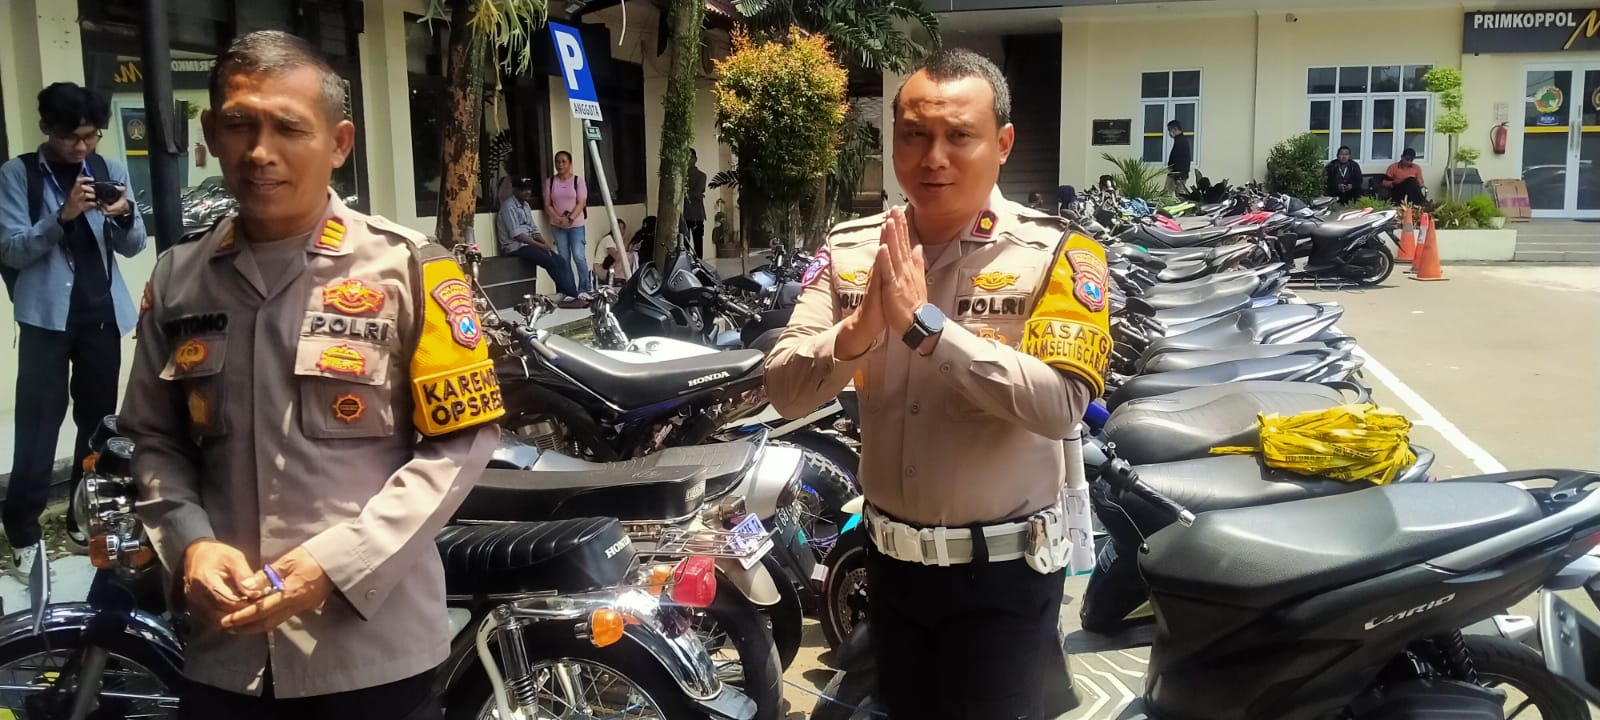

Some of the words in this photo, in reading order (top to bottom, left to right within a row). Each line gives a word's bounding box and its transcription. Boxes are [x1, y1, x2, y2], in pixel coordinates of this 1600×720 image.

[1474, 12, 1576, 29] PRIMKOPPOL
[554, 30, 584, 91] P
[573, 102, 600, 118] ANGGOTA
[958, 296, 1025, 316] POLRI
[310, 316, 390, 342] POLRI
[1028, 321, 1109, 355] KASATG
[688, 371, 730, 387] HONDA
[1365, 593, 1456, 630] VARIO
